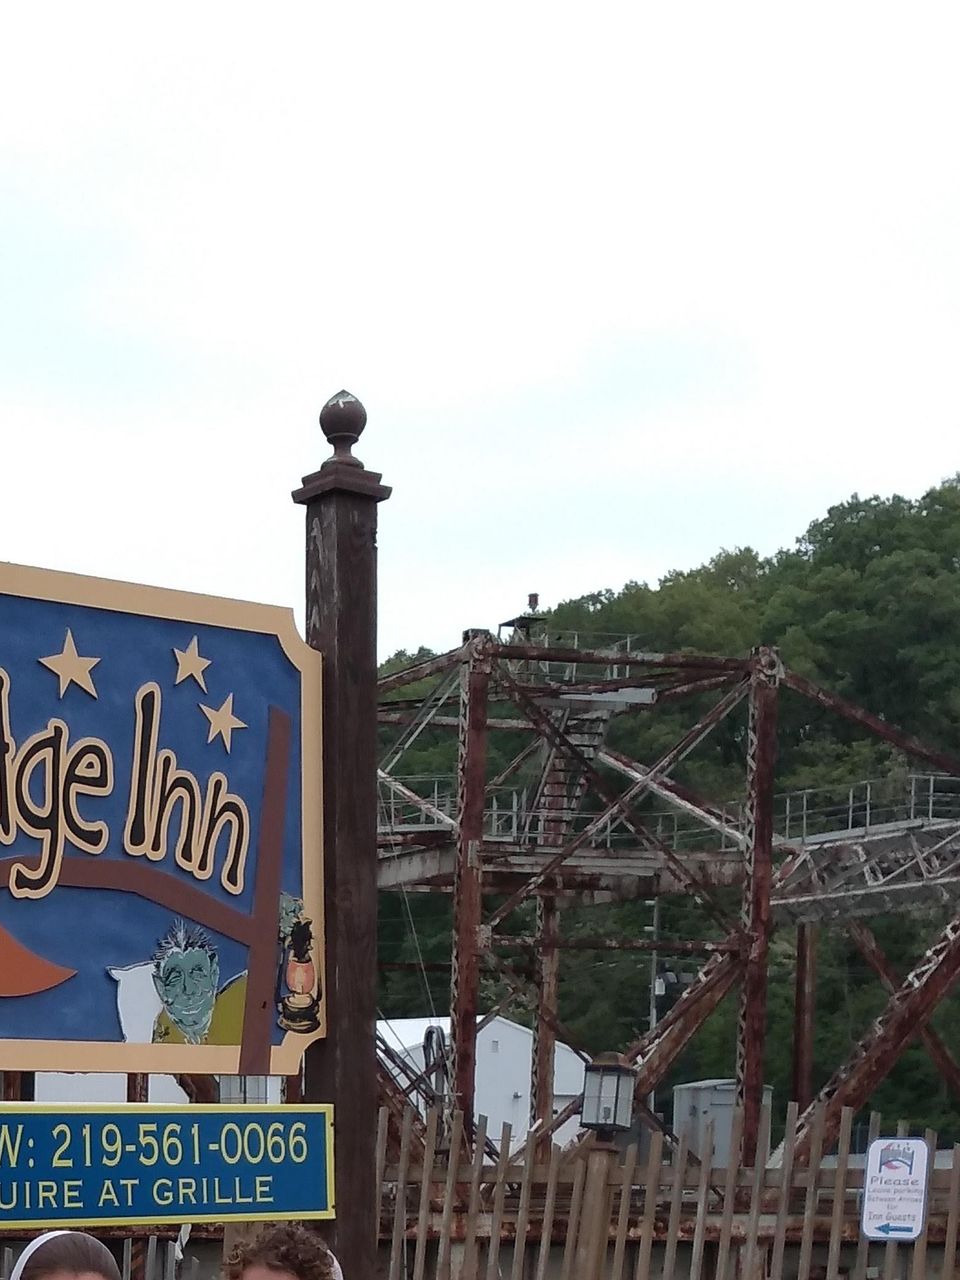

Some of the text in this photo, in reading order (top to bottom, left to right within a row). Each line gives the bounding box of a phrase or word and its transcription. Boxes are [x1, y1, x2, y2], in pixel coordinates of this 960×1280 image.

[124, 682, 250, 895] Inn
[51, 1122, 308, 1168] 219-561-0066
[98, 1179, 140, 1207] AT
[152, 1176, 274, 1206] GRILLE
[870, 1175, 919, 1186] Please
[868, 1211, 917, 1222] Inn Guests
